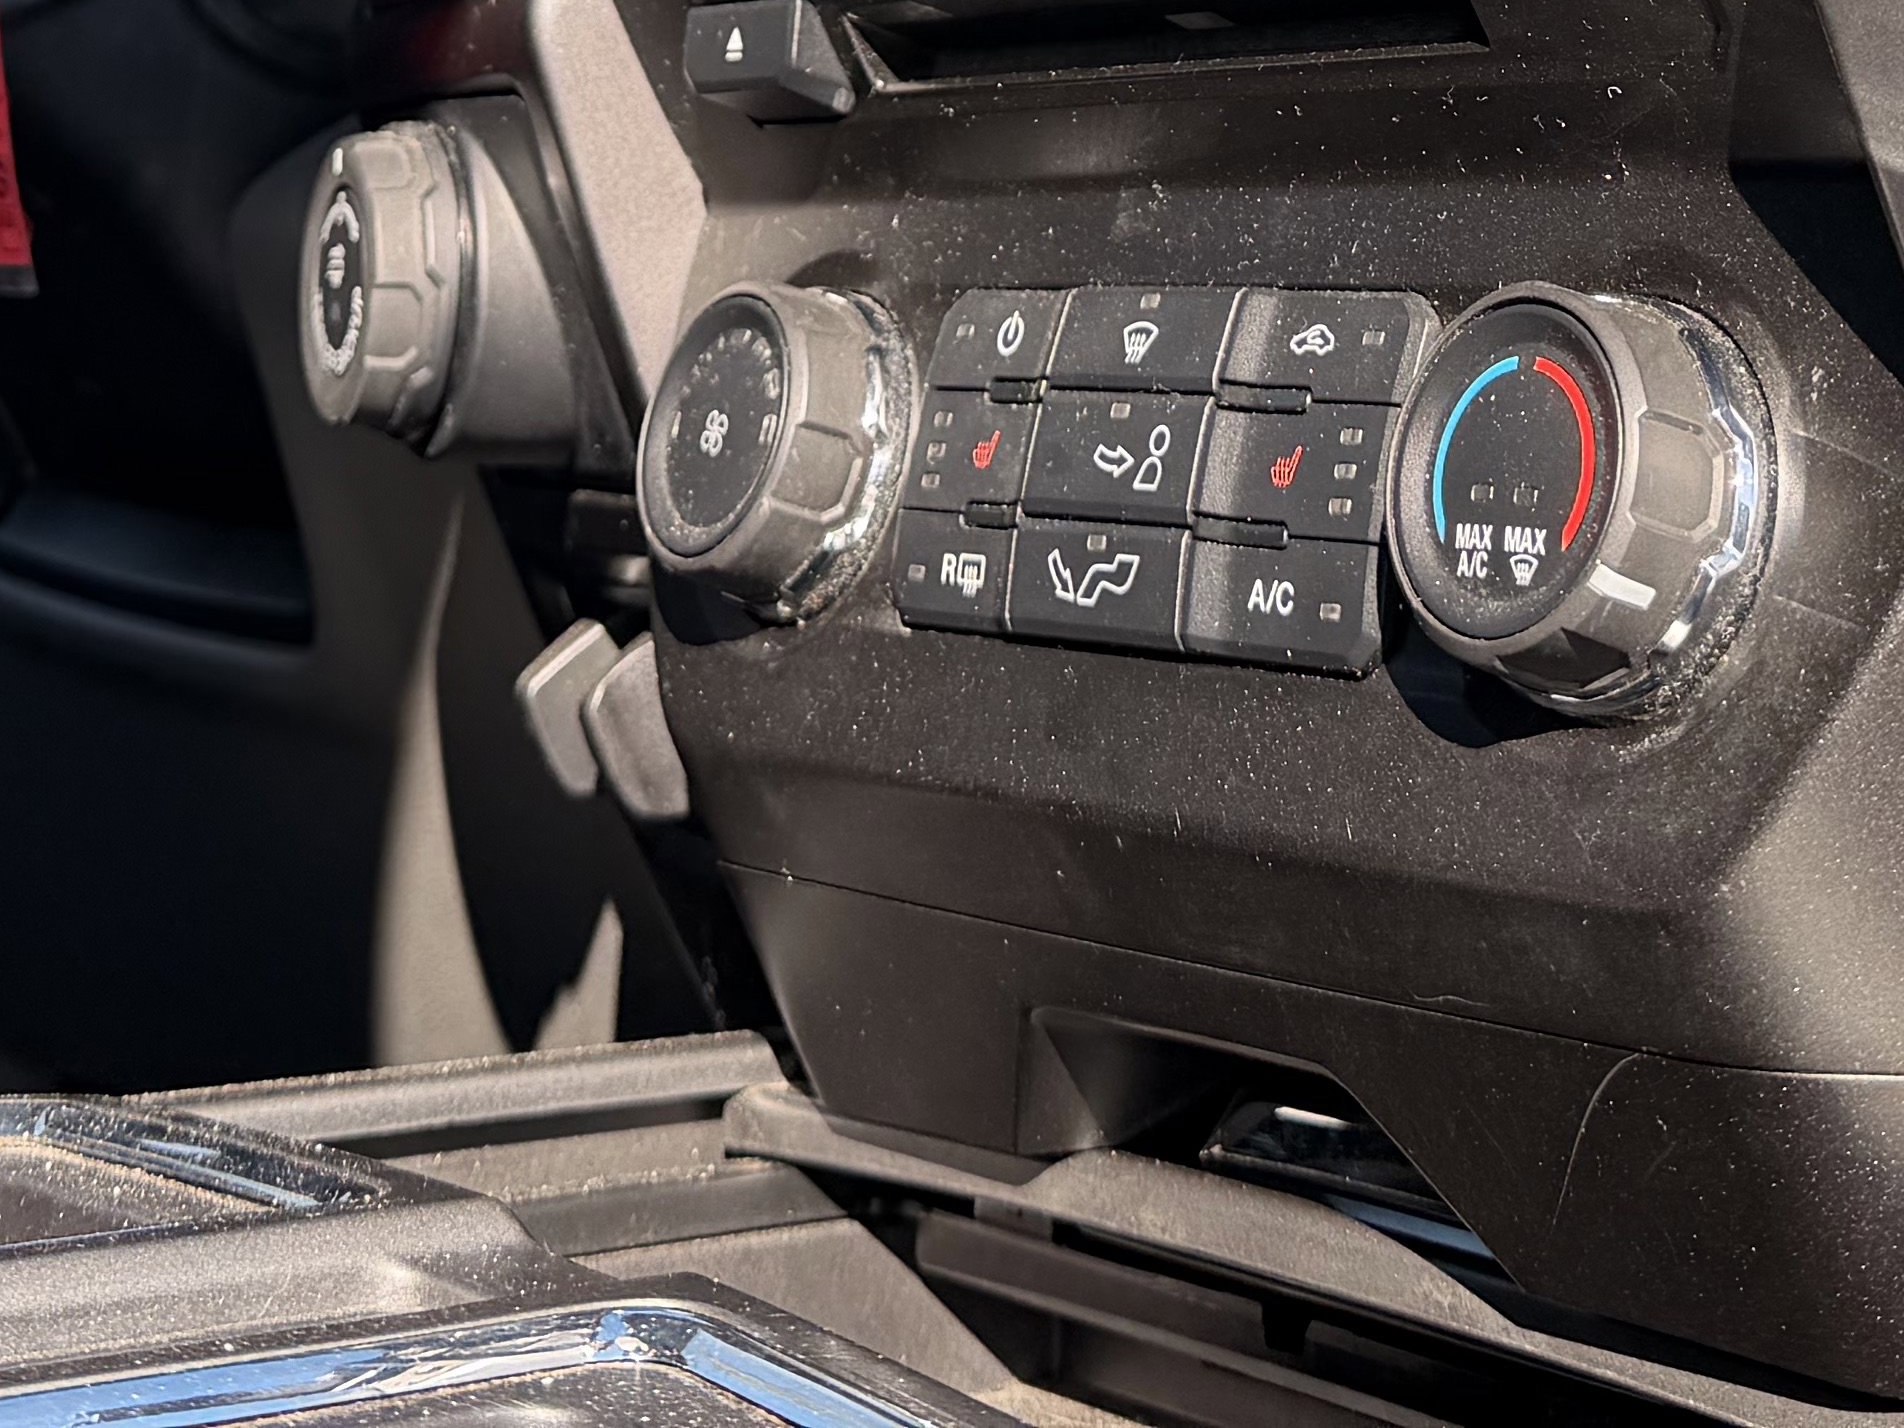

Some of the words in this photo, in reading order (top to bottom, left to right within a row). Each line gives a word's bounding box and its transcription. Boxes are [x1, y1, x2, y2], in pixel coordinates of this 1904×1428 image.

[1455, 523, 1493, 551] MAX
[1503, 525, 1547, 556] MAX
[1456, 550, 1488, 578] A/C
[1247, 580, 1295, 615] A/C
